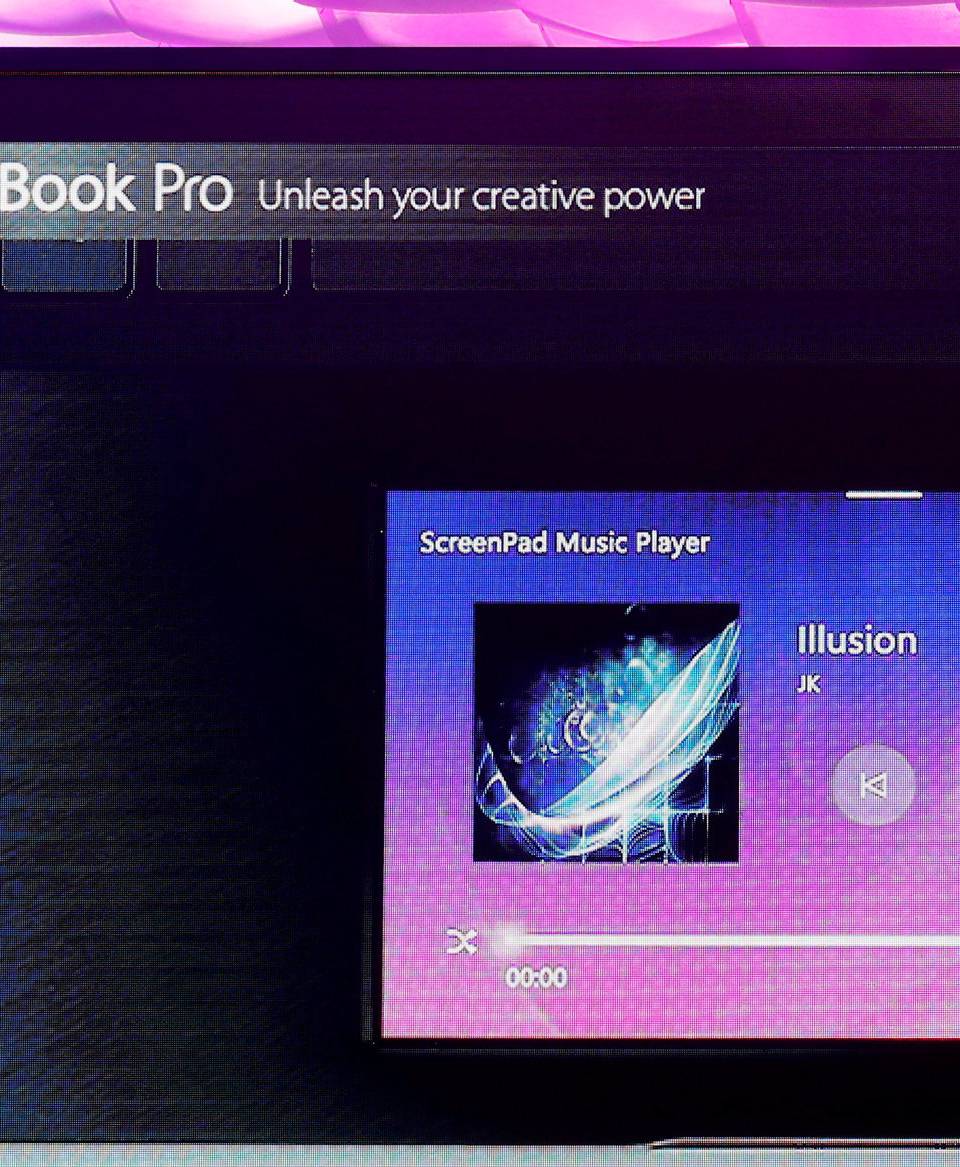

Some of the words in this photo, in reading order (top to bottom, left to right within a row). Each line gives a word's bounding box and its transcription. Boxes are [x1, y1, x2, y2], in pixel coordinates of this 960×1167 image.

[0, 162, 135, 211] Book
[155, 163, 233, 211] Pro
[259, 178, 383, 210] Unleash
[392, 188, 464, 219] your
[472, 180, 595, 210] creative
[605, 188, 705, 217] power
[420, 531, 547, 554] ScreenPad
[556, 530, 628, 554] Music
[636, 530, 711, 559] Player
[797, 624, 918, 655] Illusion
[796, 675, 821, 693] JK
[505, 966, 567, 989] 00:00
